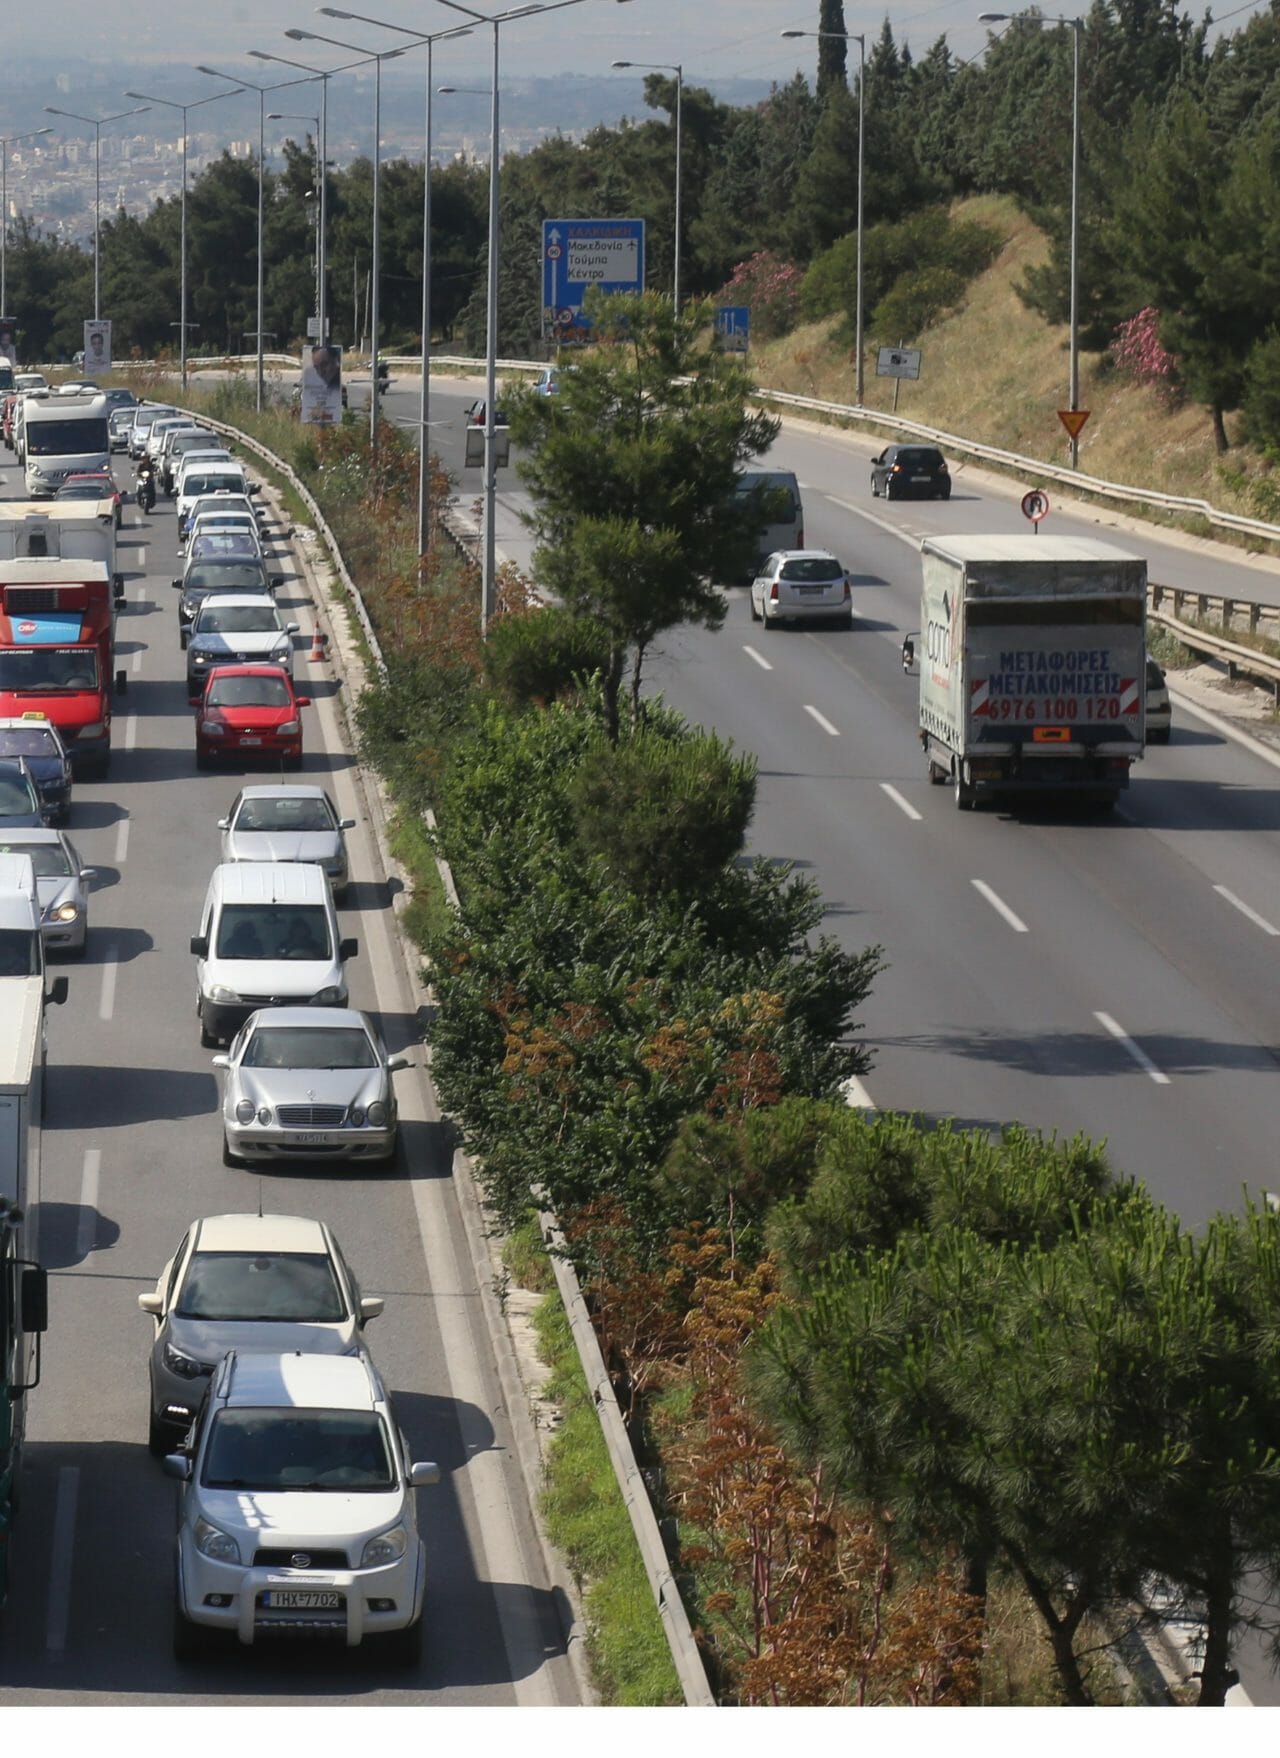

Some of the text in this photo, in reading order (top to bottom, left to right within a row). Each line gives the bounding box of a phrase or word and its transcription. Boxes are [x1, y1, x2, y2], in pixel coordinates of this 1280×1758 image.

[568, 241, 623, 250] Μακεδονία
[569, 255, 607, 265] Τούμπα
[568, 268, 604, 279] Κέντρο
[1000, 651, 1110, 672] ΜΕΤΑΦΟΡΕΣ
[989, 674, 1120, 695] ΜΕΤΑΚΟΜΙΣΕΙΣ
[989, 698, 1120, 720] 6976 100 120
